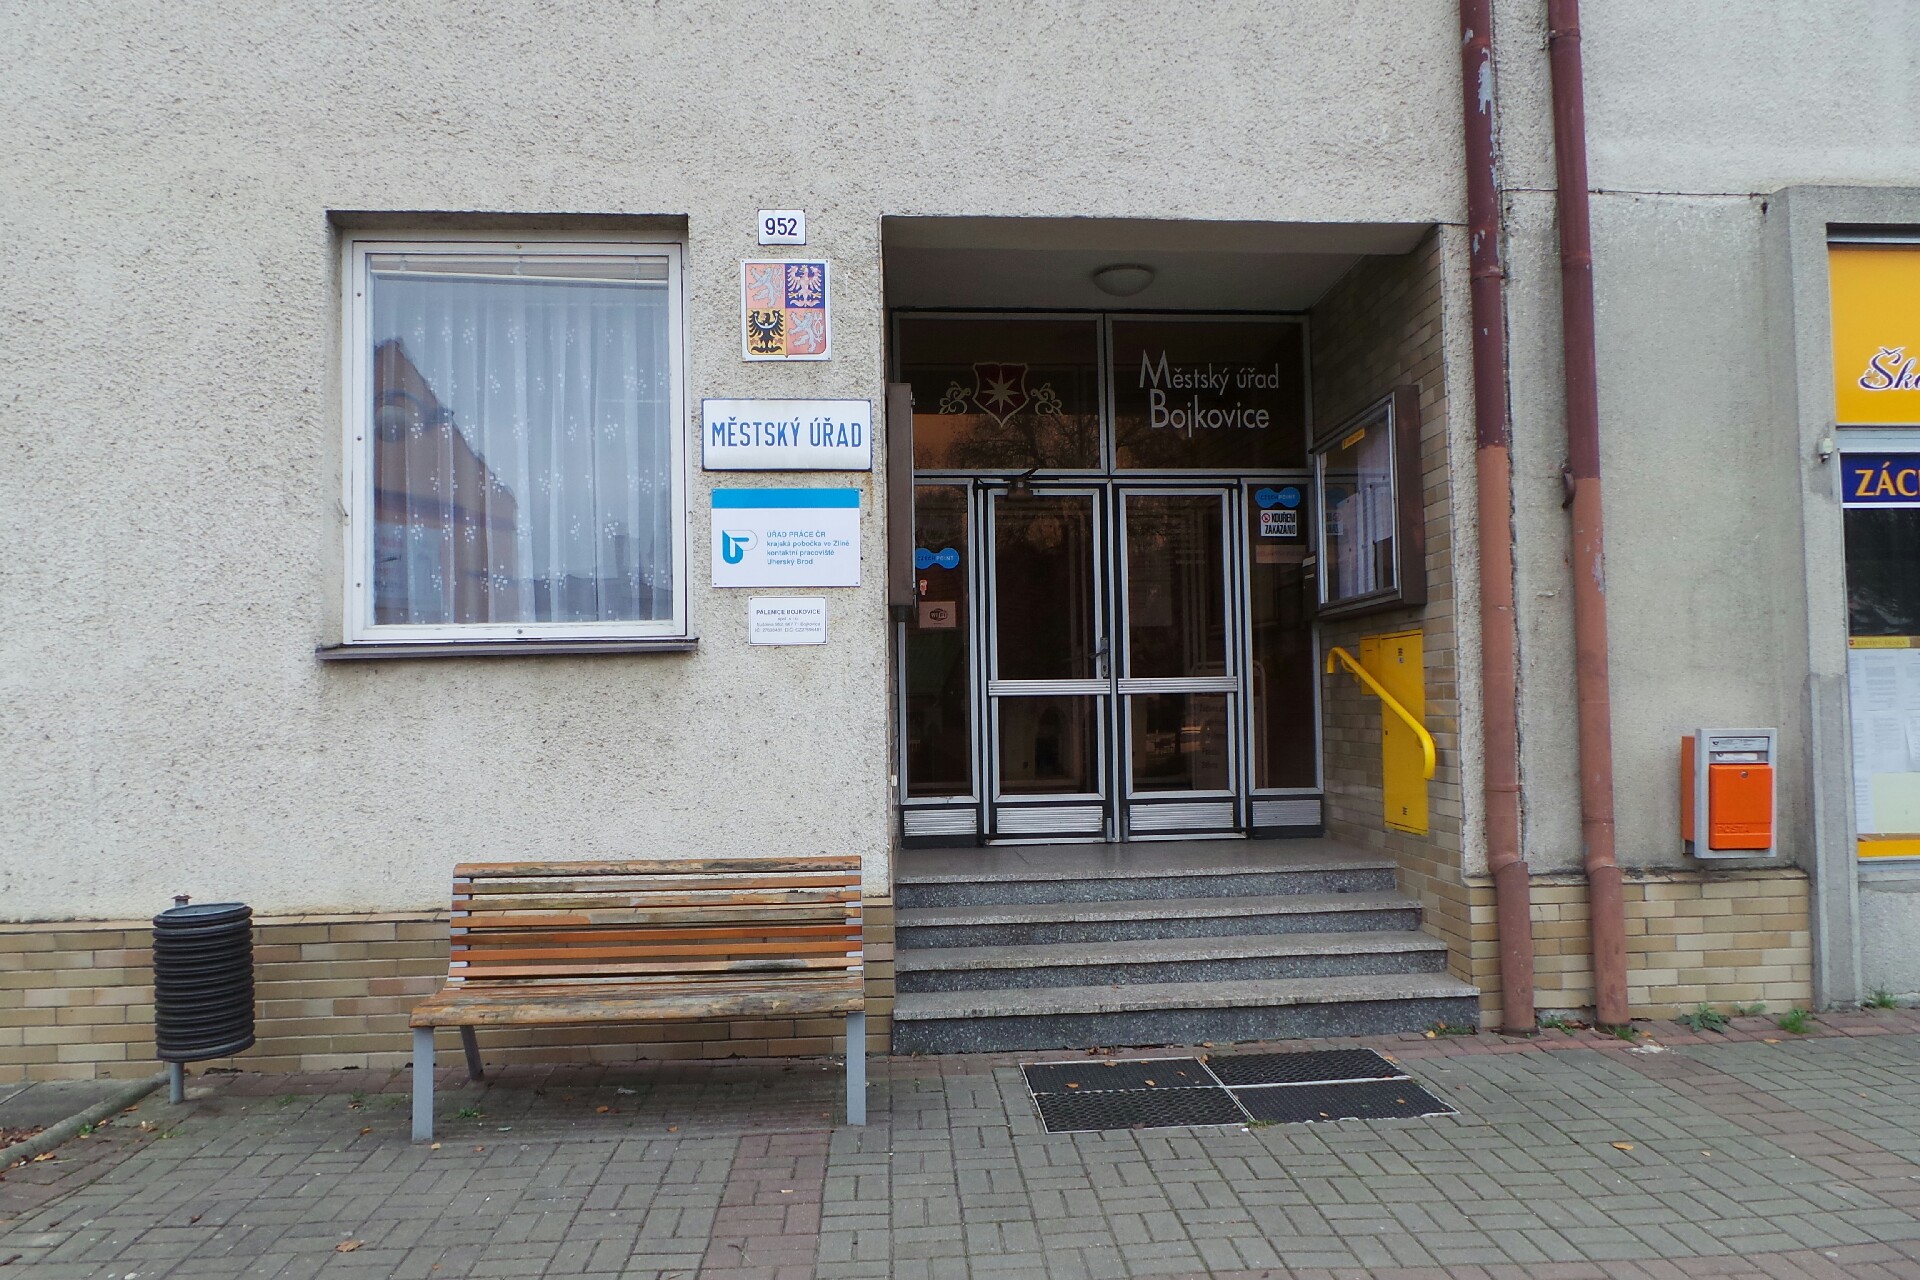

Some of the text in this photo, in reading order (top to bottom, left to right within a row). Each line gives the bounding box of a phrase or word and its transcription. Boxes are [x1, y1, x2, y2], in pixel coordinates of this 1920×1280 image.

[765, 217, 798, 236] 952
[1139, 349, 1279, 396] Městský úřad
[1858, 346, 1920, 390] Šk
[1149, 388, 1270, 438] Bojkovice
[711, 416, 862, 448] MĚSTSKÝ ÚŘAD
[1854, 461, 1920, 497] ZÁC
[1271, 511, 1296, 523] KOUŘENÍ
[766, 529, 787, 538] ÚŘAD
[788, 529, 814, 538] PRÁCE
[1264, 523, 1296, 535] ZAKÁZÁNO
[766, 540, 791, 548] krajská
[792, 540, 822, 548] pobočka
[799, 549, 835, 557] pracoviště
